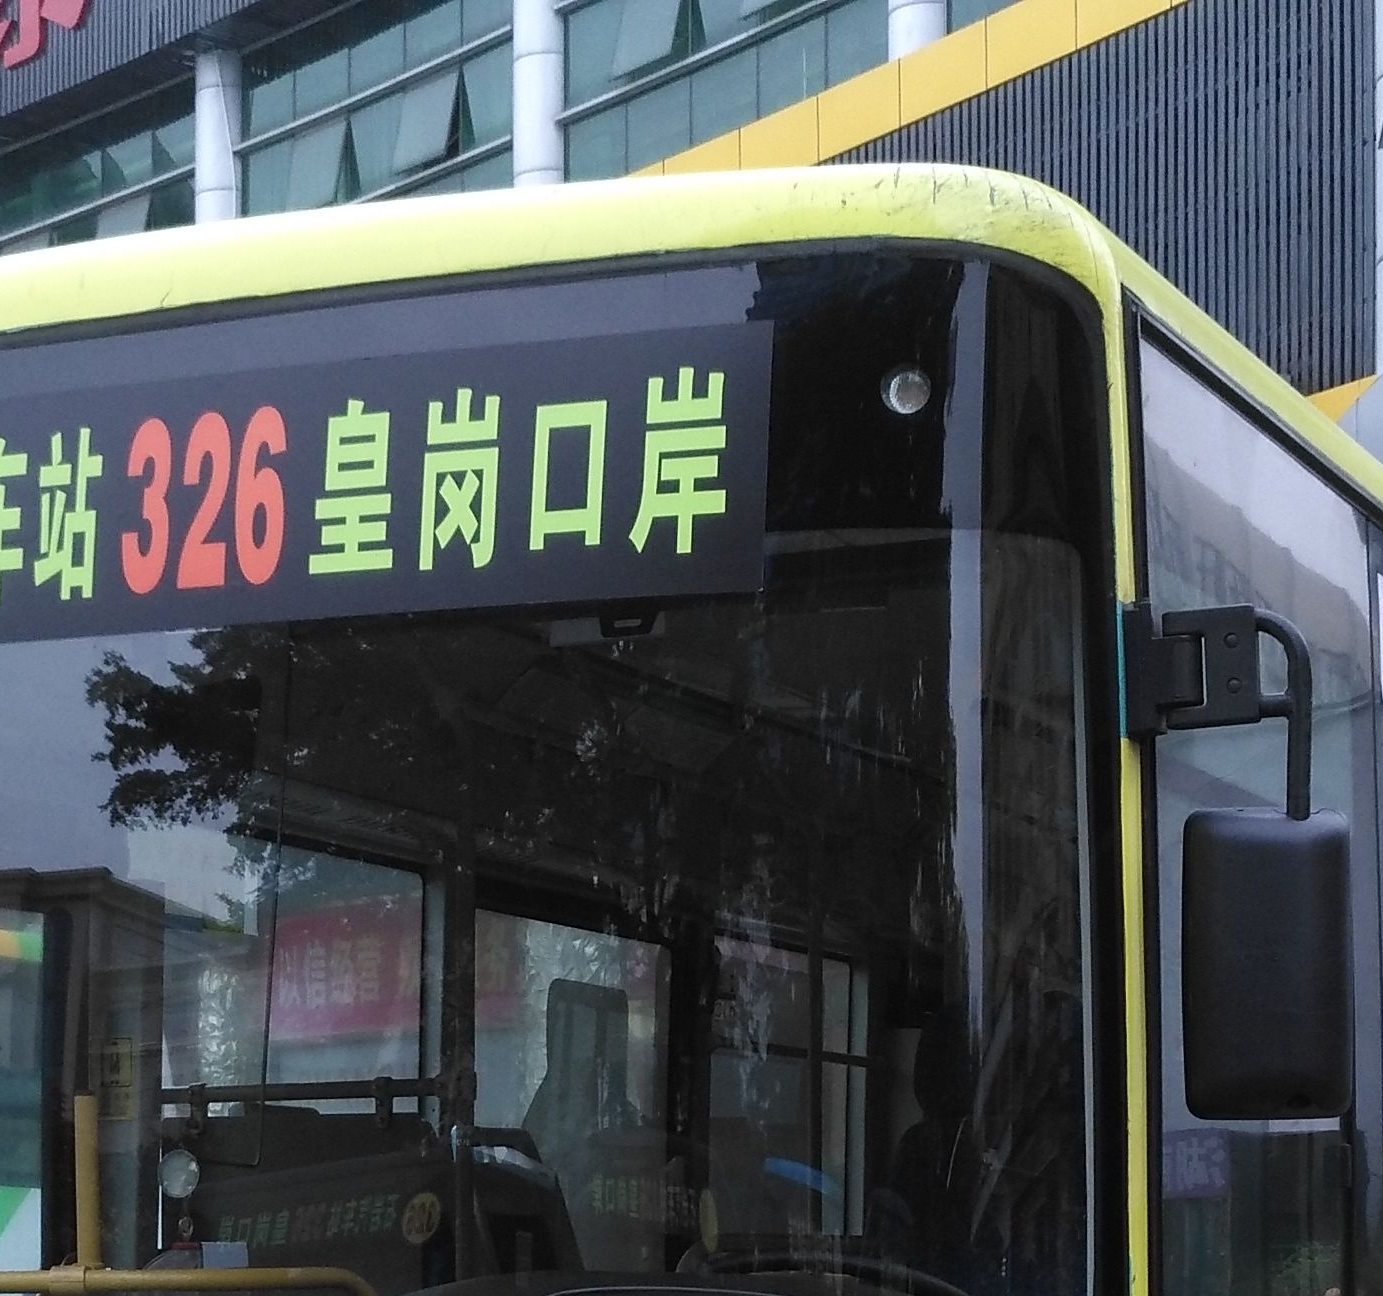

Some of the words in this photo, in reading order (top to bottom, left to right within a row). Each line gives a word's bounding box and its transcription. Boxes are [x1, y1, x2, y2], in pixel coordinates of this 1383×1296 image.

[120, 402, 291, 597] 326
[308, 365, 728, 578] 皇岗口岸
